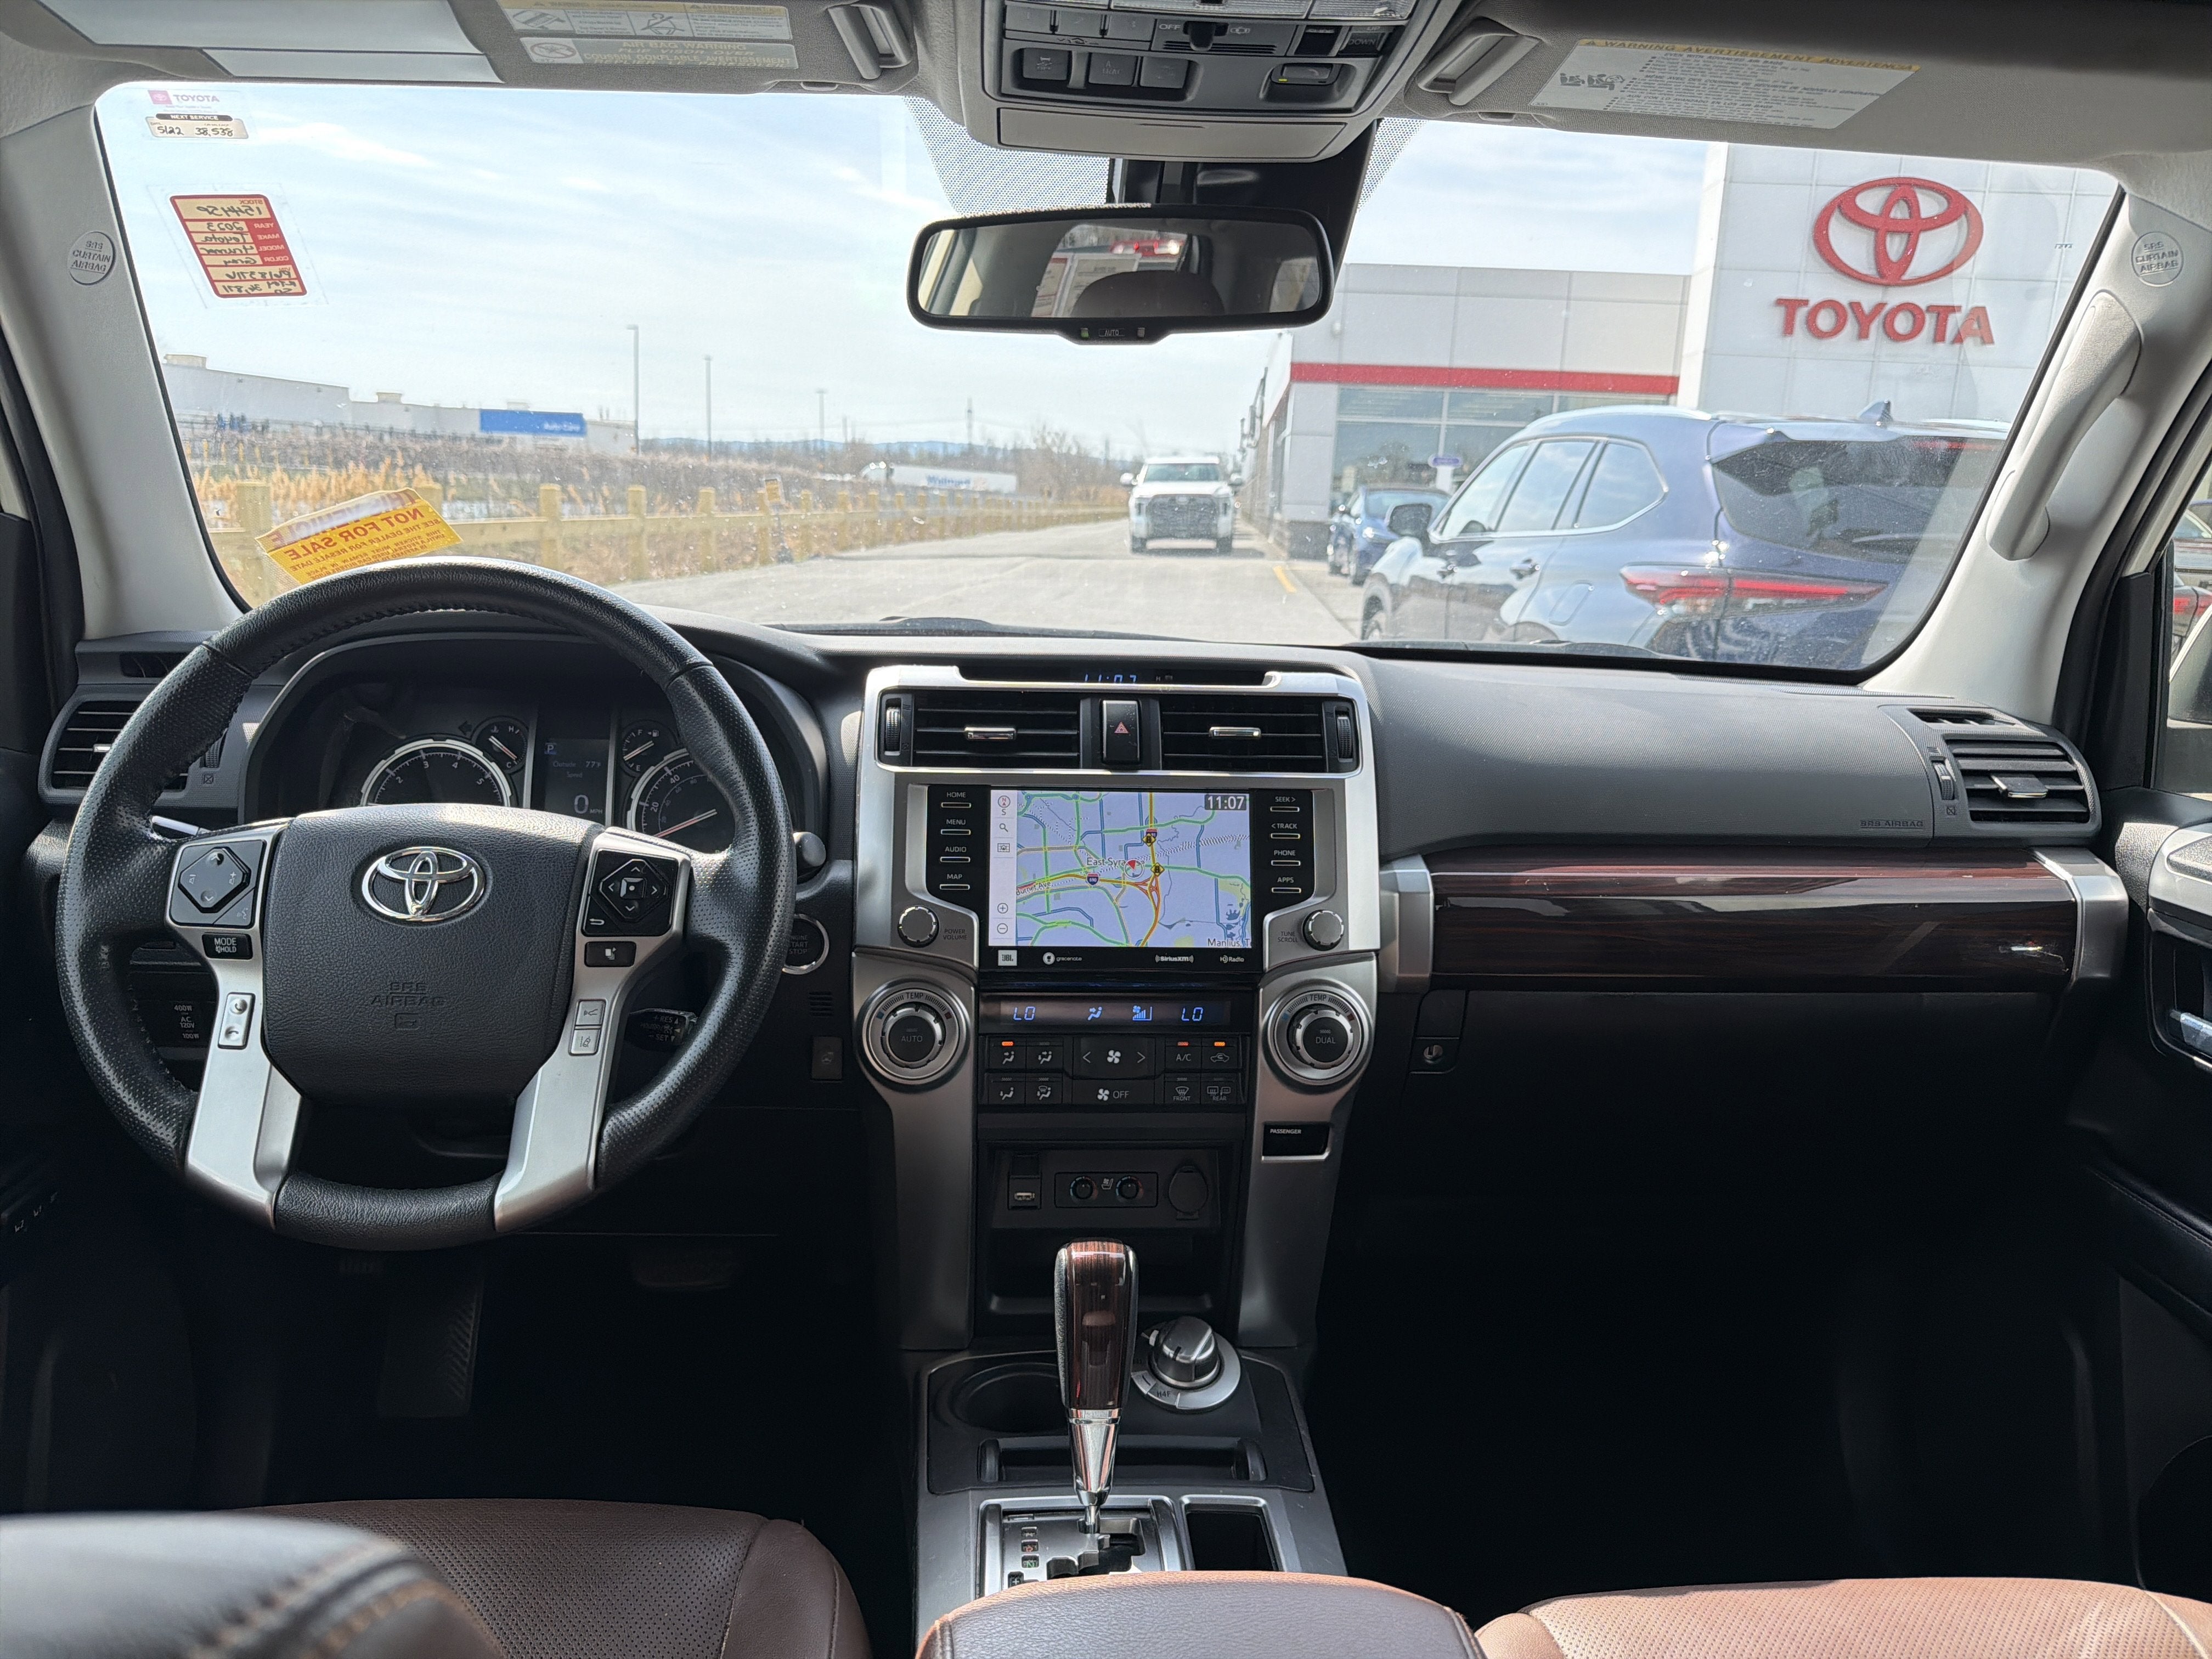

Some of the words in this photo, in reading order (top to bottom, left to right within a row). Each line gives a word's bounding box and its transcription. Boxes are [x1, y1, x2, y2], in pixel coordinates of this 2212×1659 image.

[1348, 38, 1375, 46] DOWN
[1604, 41, 1676, 51] WARNING
[1684, 46, 1811, 62] AVERTISSEMENT
[706, 55, 790, 64] AVERTISSEMENT
[173, 94, 220, 103] TOYOTA
[86, 240, 103, 250] SRS
[2143, 241, 2164, 251] SRS
[72, 250, 111, 263] CURTAIN
[2135, 250, 2180, 263] CURTAIN
[71, 259, 106, 272] AIRBAG
[2140, 260, 2180, 273] AIRBAG
[1775, 297, 1996, 347] TOYOTA
[547, 744, 554, 753] P
[396, 776, 404, 784] 2
[670, 775, 680, 784] 40
[574, 794, 589, 814] 0
[650, 802, 659, 812] 20
[1207, 796, 1245, 810] 11:07
[1087, 857, 1105, 866] East
[1015, 884, 1036, 896] Burnet
[214, 938, 237, 946] MODE
[1013, 1006, 1036, 1021] LO
[1181, 1007, 1204, 1021] LO
[1176, 1053, 1192, 1062] A/C
